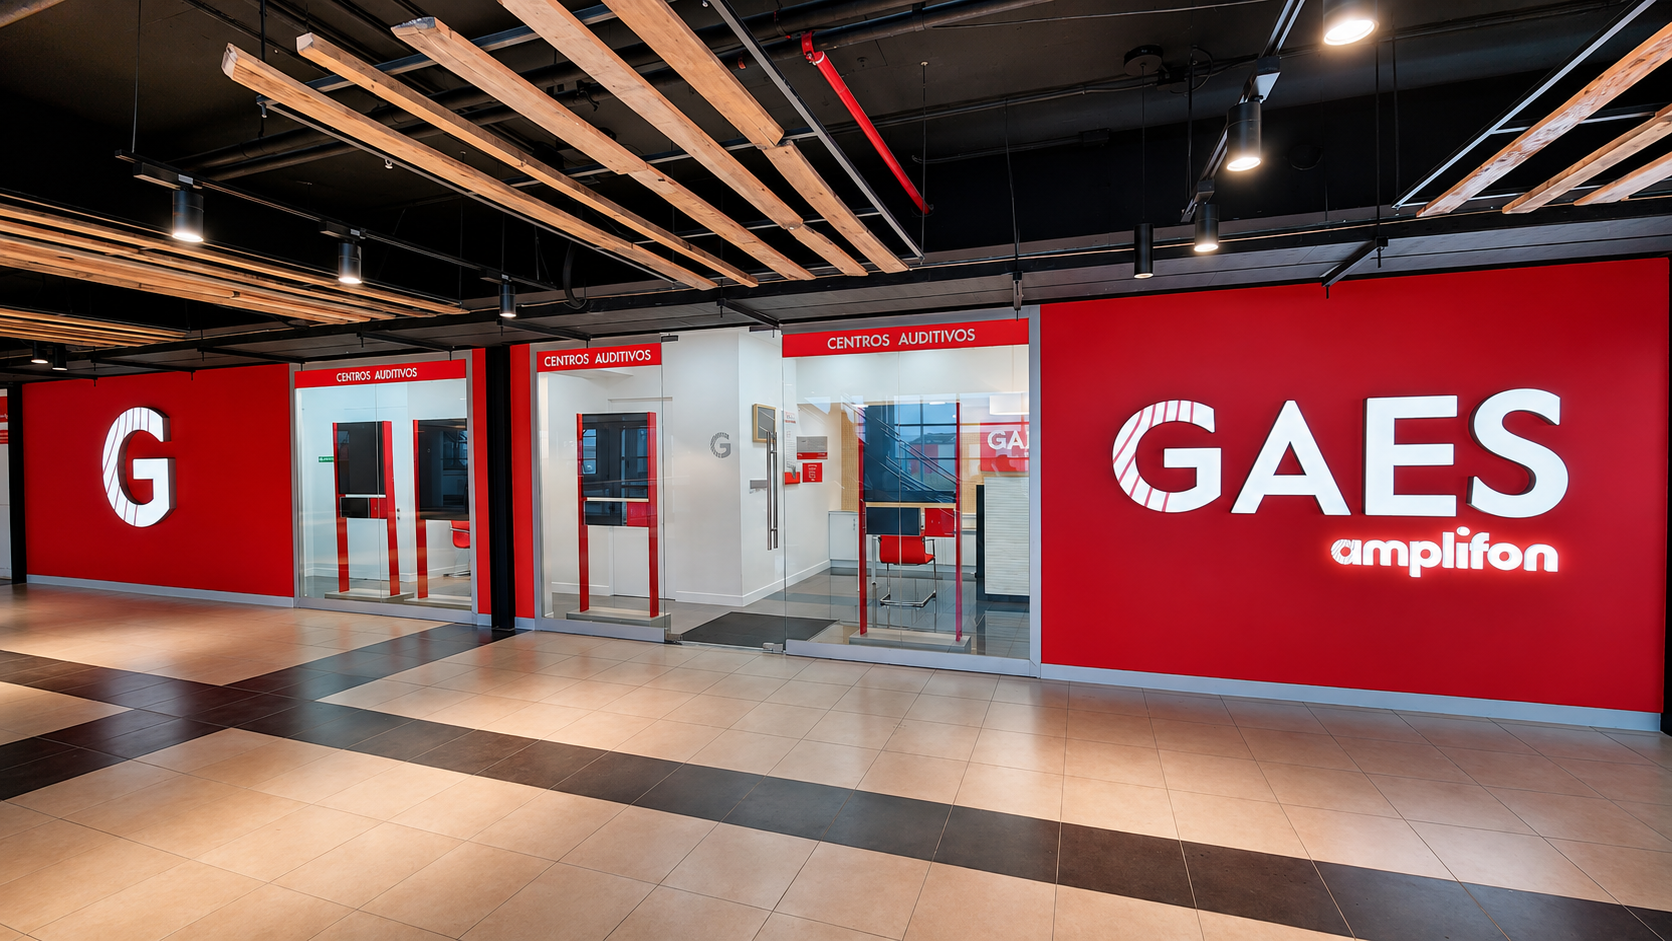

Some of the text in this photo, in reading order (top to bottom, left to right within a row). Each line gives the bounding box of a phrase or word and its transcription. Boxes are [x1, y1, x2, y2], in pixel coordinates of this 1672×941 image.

[827, 328, 976, 349] CENTROS AUDITIVOS
[544, 349, 651, 367] CENTROS AUDITIVOS
[336, 367, 418, 382] CENTROS AUDITIVOS
[987, 430, 1029, 449] GA
[1112, 388, 1570, 519] GAES
[102, 406, 177, 527] G
[1330, 526, 1560, 578] amplifon
